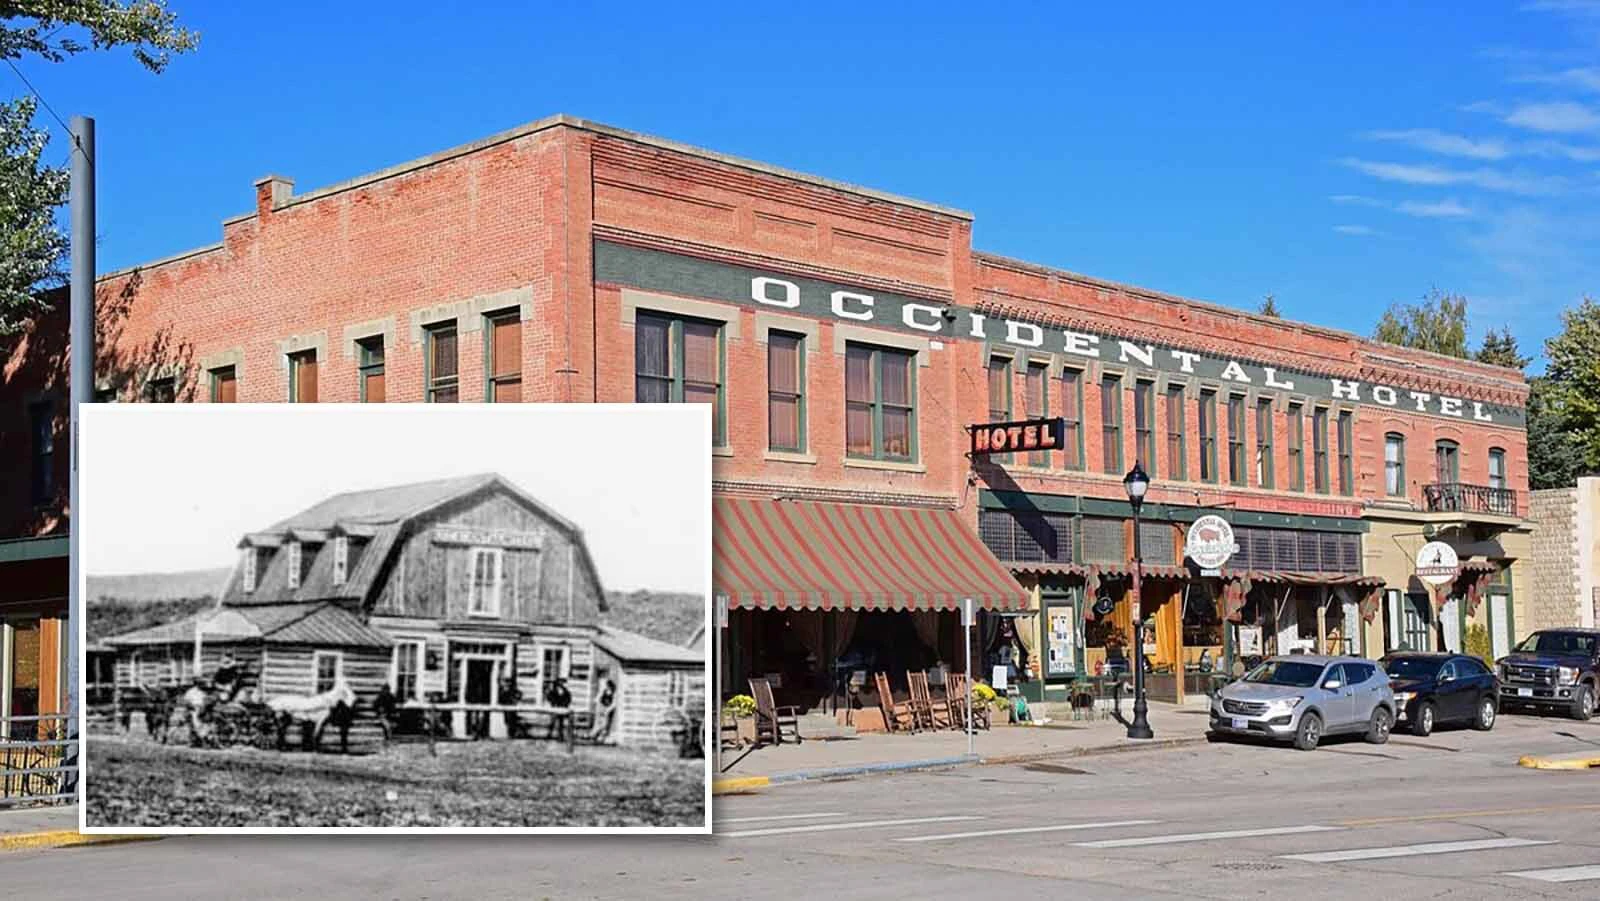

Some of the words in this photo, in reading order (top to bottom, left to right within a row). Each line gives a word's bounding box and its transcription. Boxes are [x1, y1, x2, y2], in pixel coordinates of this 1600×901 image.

[751, 275, 1294, 390] OCCIDENTAL
[1331, 378, 1493, 422] HOTEL
[975, 424, 1056, 450] HOTEL
